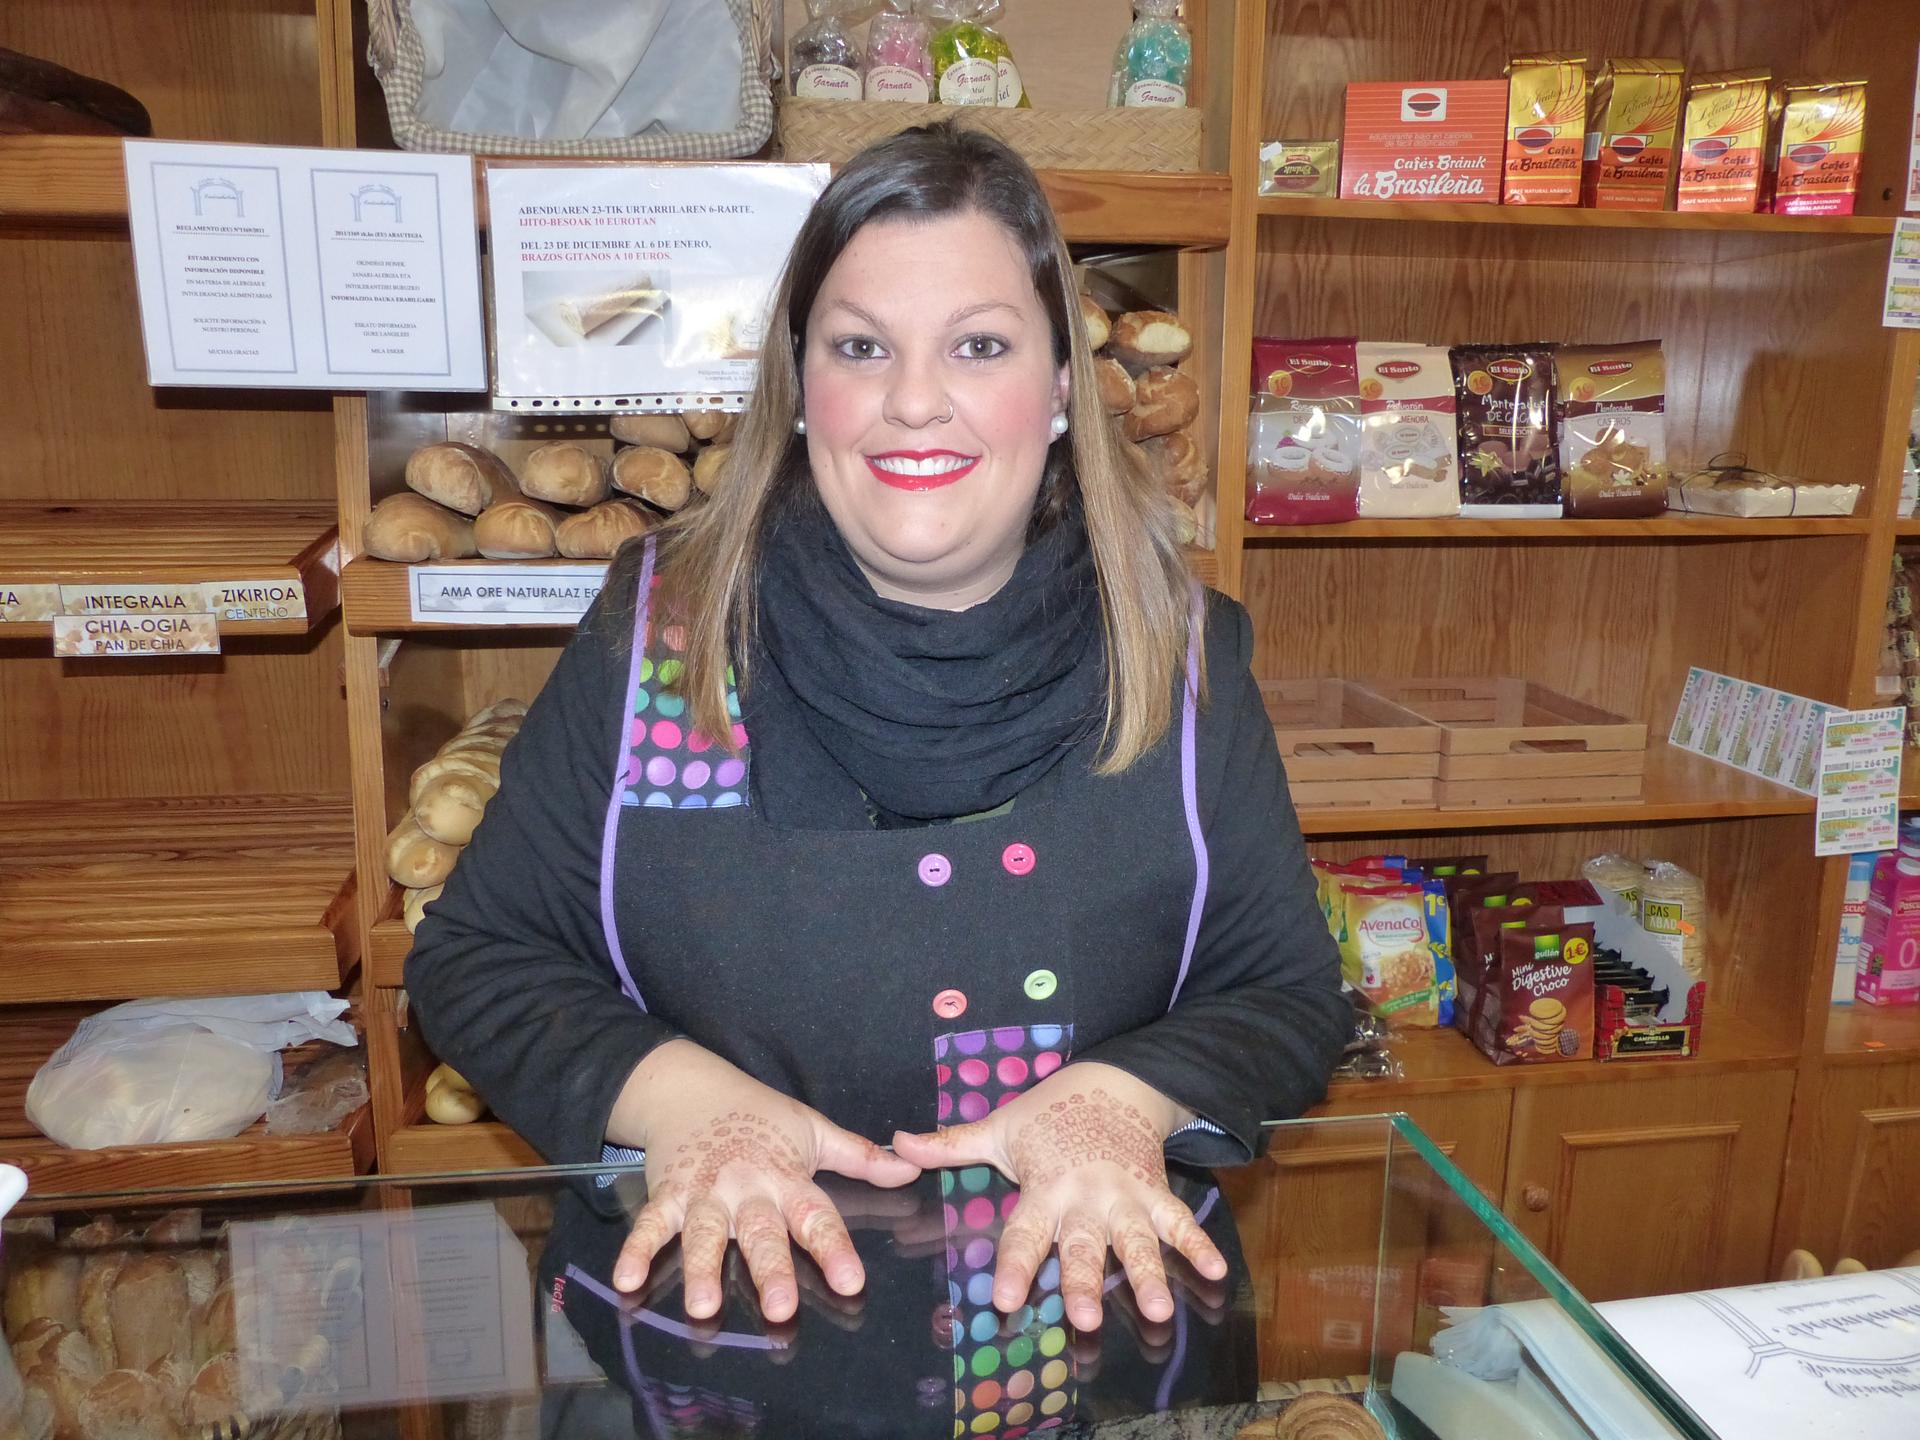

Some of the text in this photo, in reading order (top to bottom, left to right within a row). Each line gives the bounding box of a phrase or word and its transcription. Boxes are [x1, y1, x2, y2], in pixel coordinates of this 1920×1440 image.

[814, 75, 848, 88] Garnata
[878, 79, 912, 92] Garnata
[1141, 90, 1176, 102] Garnata
[1548, 146, 1575, 154] Cafés
[1394, 156, 1434, 170] Cafés
[1509, 158, 1577, 172] la Brasileña
[1638, 156, 1664, 164] Cafés
[1722, 156, 1751, 166] Cafés
[1820, 160, 1850, 170] Cafés
[1603, 169, 1612, 178] la
[1683, 168, 1753, 182] la Brasileña
[1354, 171, 1484, 200] la Brasileña
[1780, 177, 1790, 187] la
[518, 205, 589, 215] ABENDUAREN
[592, 204, 622, 214] 23-TIK
[626, 204, 706, 214] URTARRILAREN
[594, 218, 604, 226] 10
[607, 217, 656, 226] EUROTAN
[521, 242, 542, 250] DEL
[544, 242, 554, 250] 23
[556, 242, 570, 250] DE
[573, 241, 630, 250] DICIEMBRE
[634, 241, 648, 249] AL
[650, 241, 656, 249] 6
[522, 253, 563, 262] BRAZOS
[565, 253, 612, 262] GITANOS
[624, 253, 633, 261] 10
[1290, 358, 1330, 367] El Santo
[1602, 364, 1632, 372] Santo
[1378, 366, 1389, 374] El
[1502, 366, 1528, 374] Santo
[222, 587, 298, 602] ZIKIRIOA
[441, 586, 580, 598] AMA ORE NATURALAZ
[85, 595, 186, 610] INTEGRALA
[224, 607, 288, 620] CENTENO
[85, 618, 192, 634] CHIA-OGIA
[96, 639, 185, 651] PAN DE CHIA
[1425, 894, 1444, 916] 1€
[1535, 949, 1560, 960] gullón
[1566, 943, 1586, 960] 1€
[1512, 962, 1534, 978] Mini
[1512, 965, 1572, 990] Digestive
[1534, 978, 1570, 996] Choco
